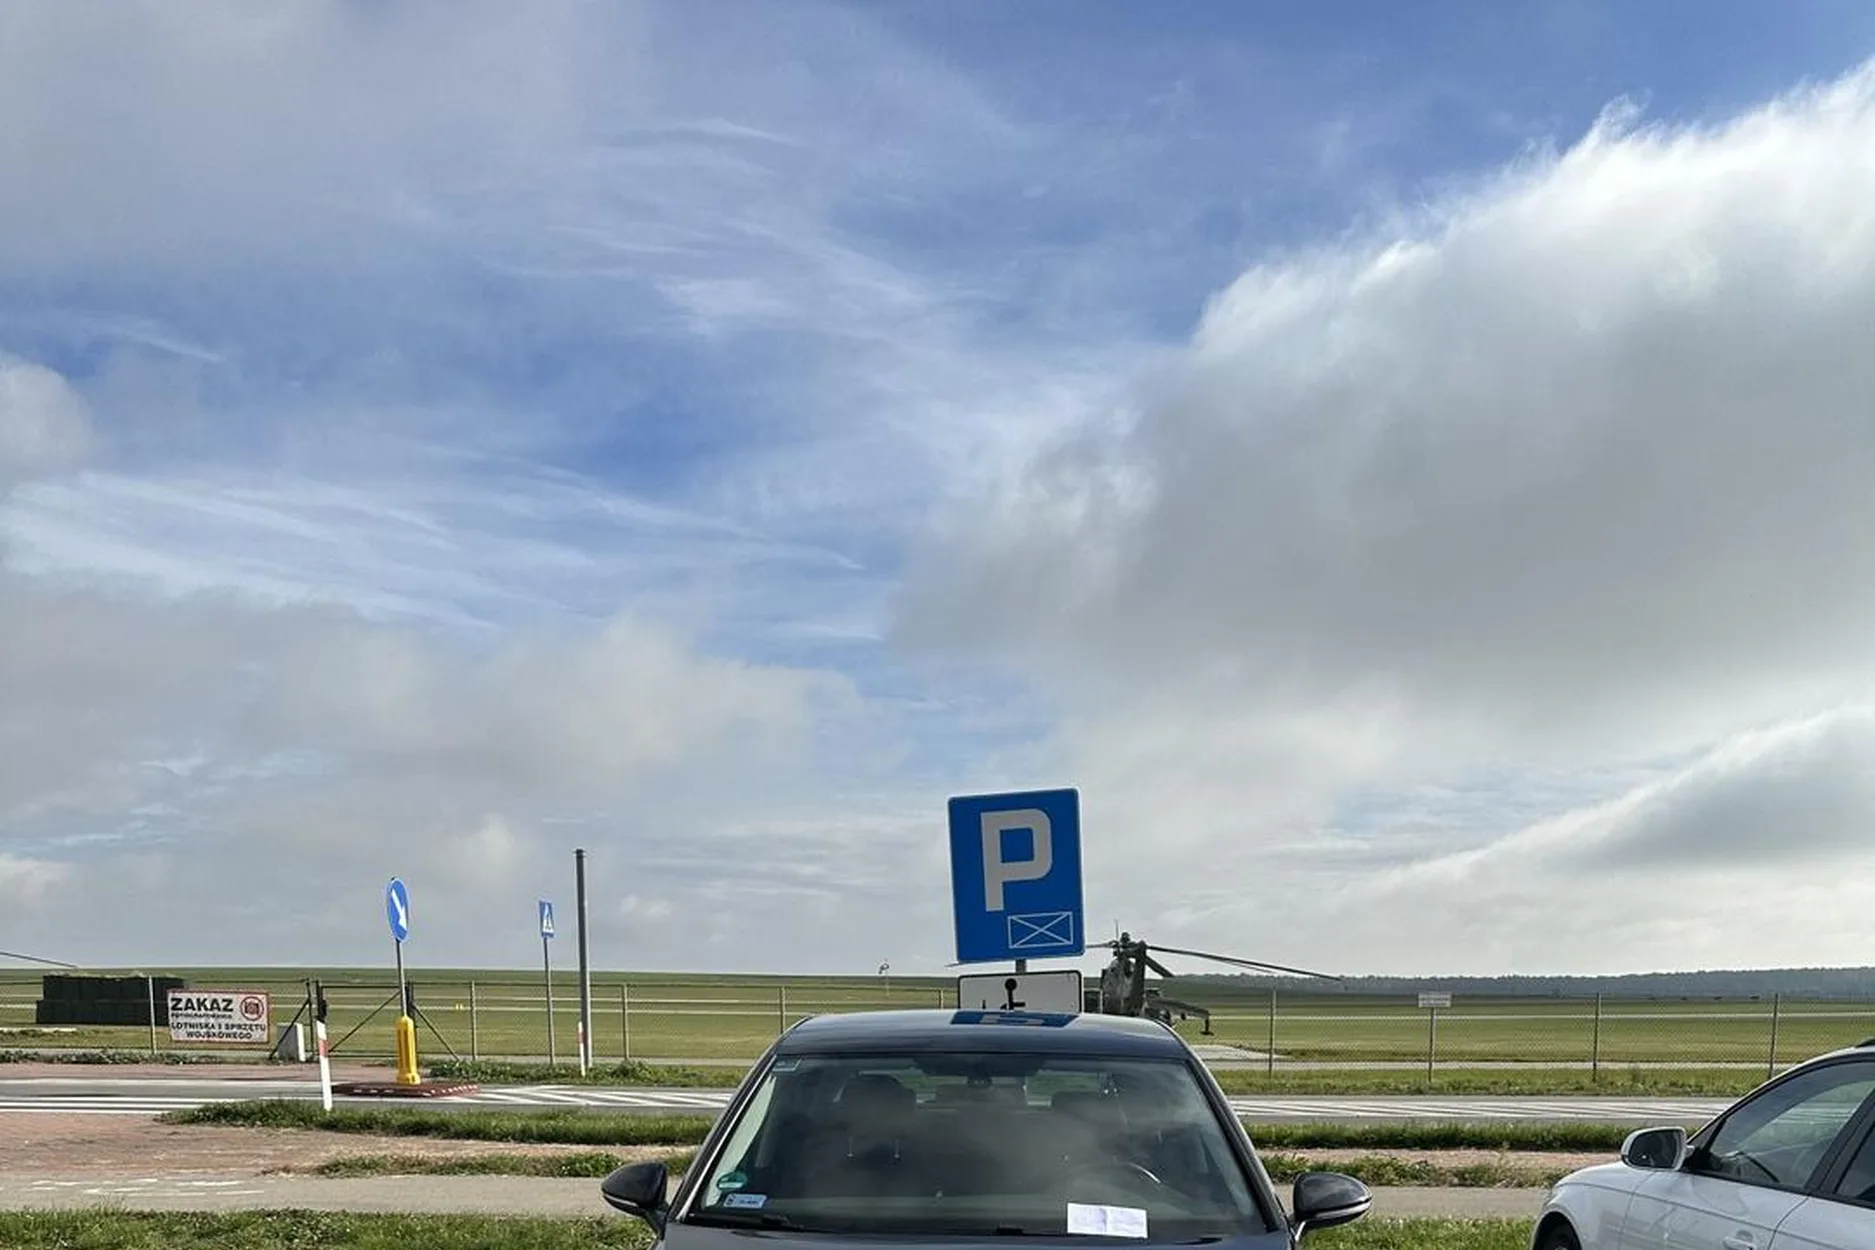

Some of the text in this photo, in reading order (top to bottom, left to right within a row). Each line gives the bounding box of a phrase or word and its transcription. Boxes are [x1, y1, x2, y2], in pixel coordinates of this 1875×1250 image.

[980, 808, 1053, 912] P
[171, 998, 234, 1012] ZAKAZ
[171, 1022, 216, 1031] LOTNISKA
[186, 1031, 253, 1040] WOJSKOWEGO
